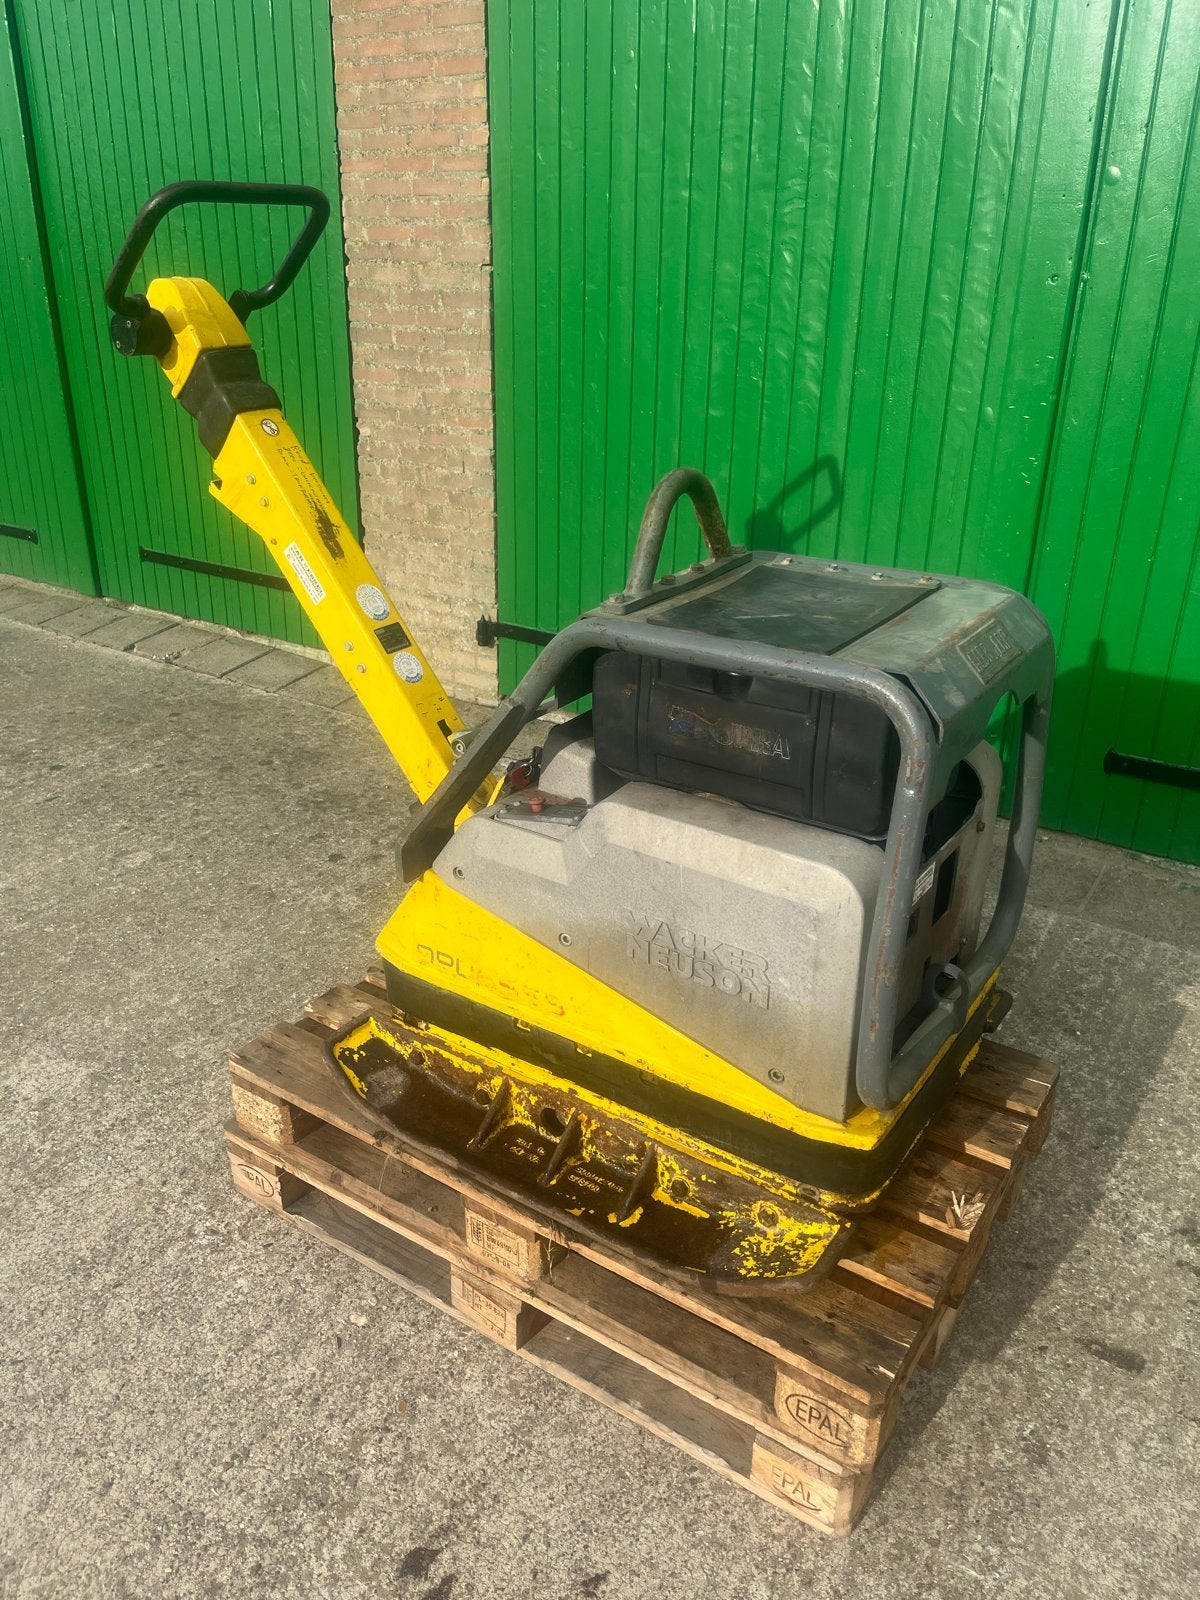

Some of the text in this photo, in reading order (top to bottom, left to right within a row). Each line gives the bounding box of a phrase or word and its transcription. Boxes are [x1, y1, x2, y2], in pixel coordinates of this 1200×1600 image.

[624, 906, 771, 984] WACKER
[626, 932, 770, 1010] NEUSON
[795, 1399, 849, 1444] EPAL
